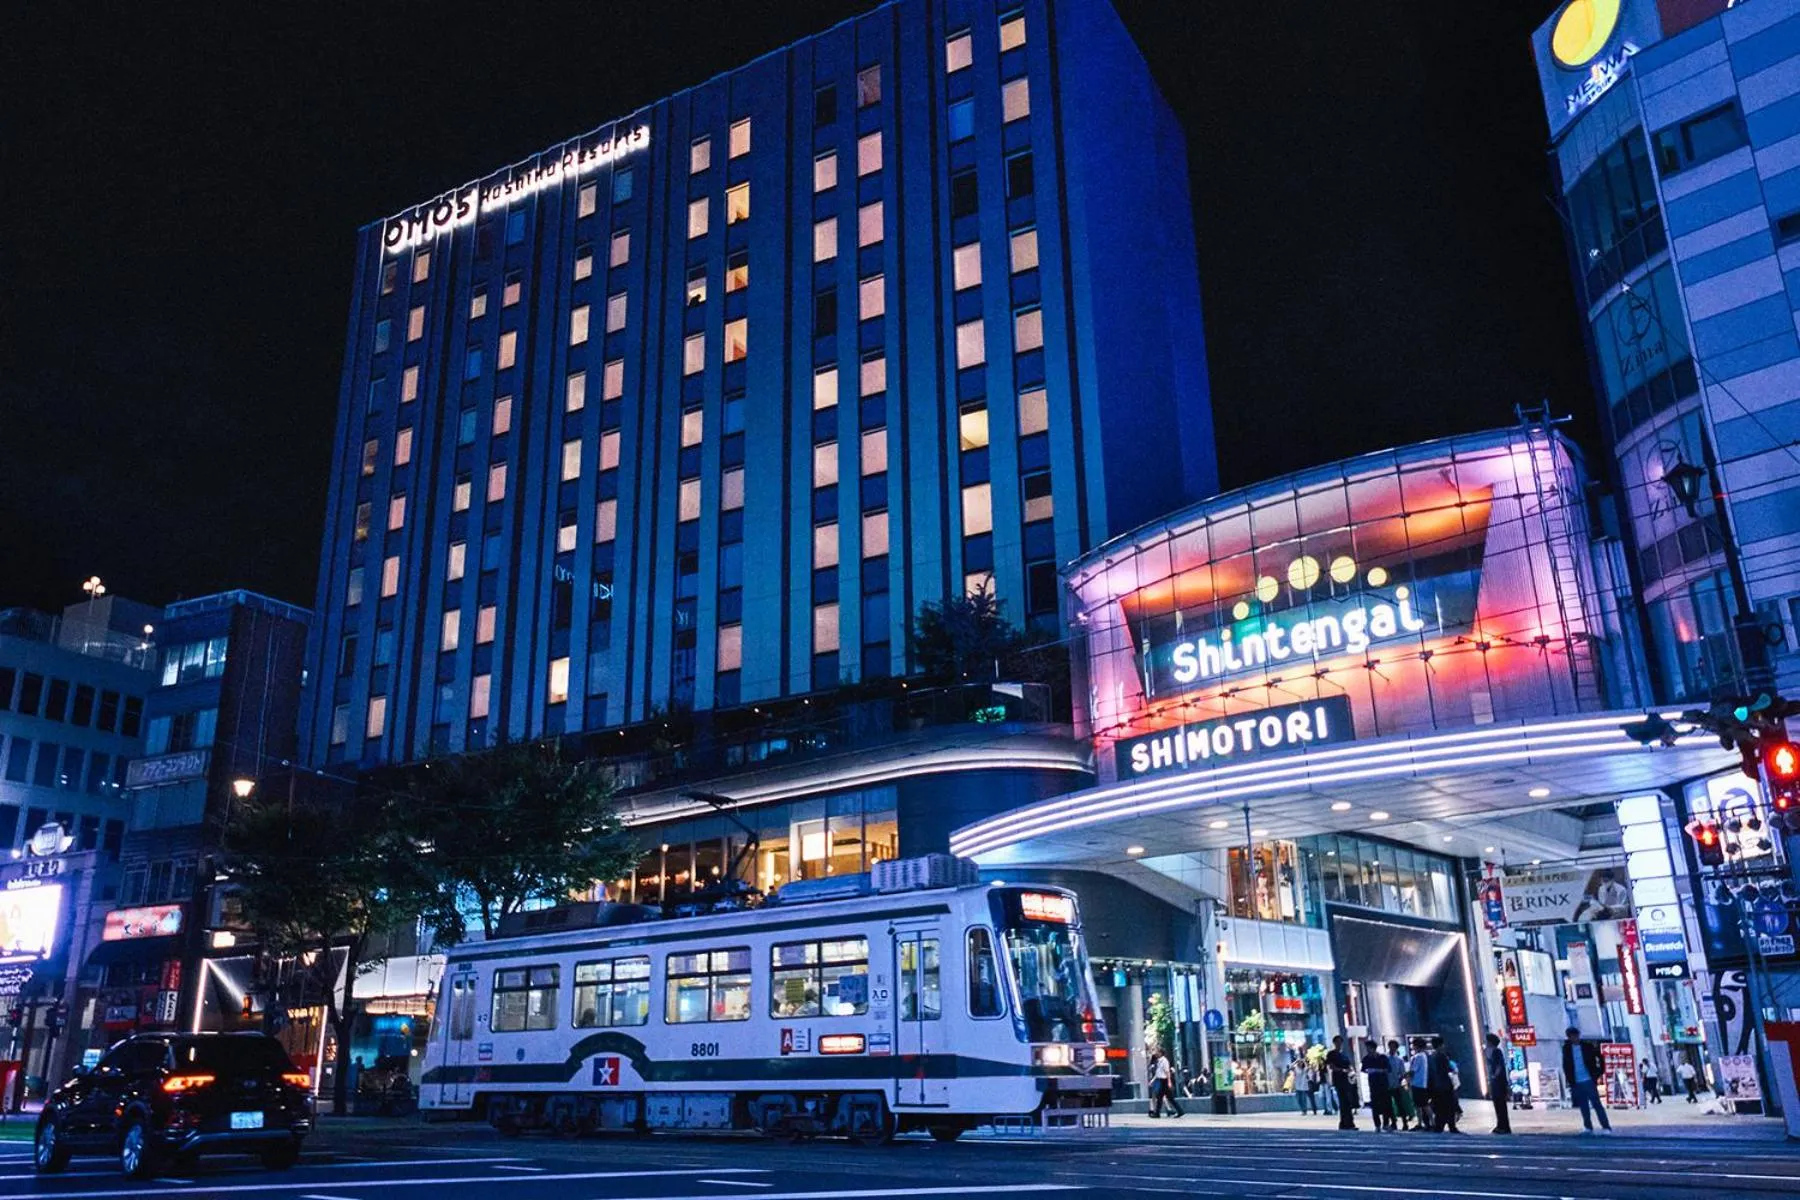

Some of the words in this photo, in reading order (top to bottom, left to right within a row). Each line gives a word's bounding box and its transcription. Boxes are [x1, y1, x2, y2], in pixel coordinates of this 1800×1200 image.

[383, 190, 472, 247] OMO5
[1172, 585, 1425, 685] Shintengai
[1130, 706, 1330, 773] SHIMOTORI
[1525, 892, 1571, 909] RINX
[690, 1042, 720, 1057] 8801
